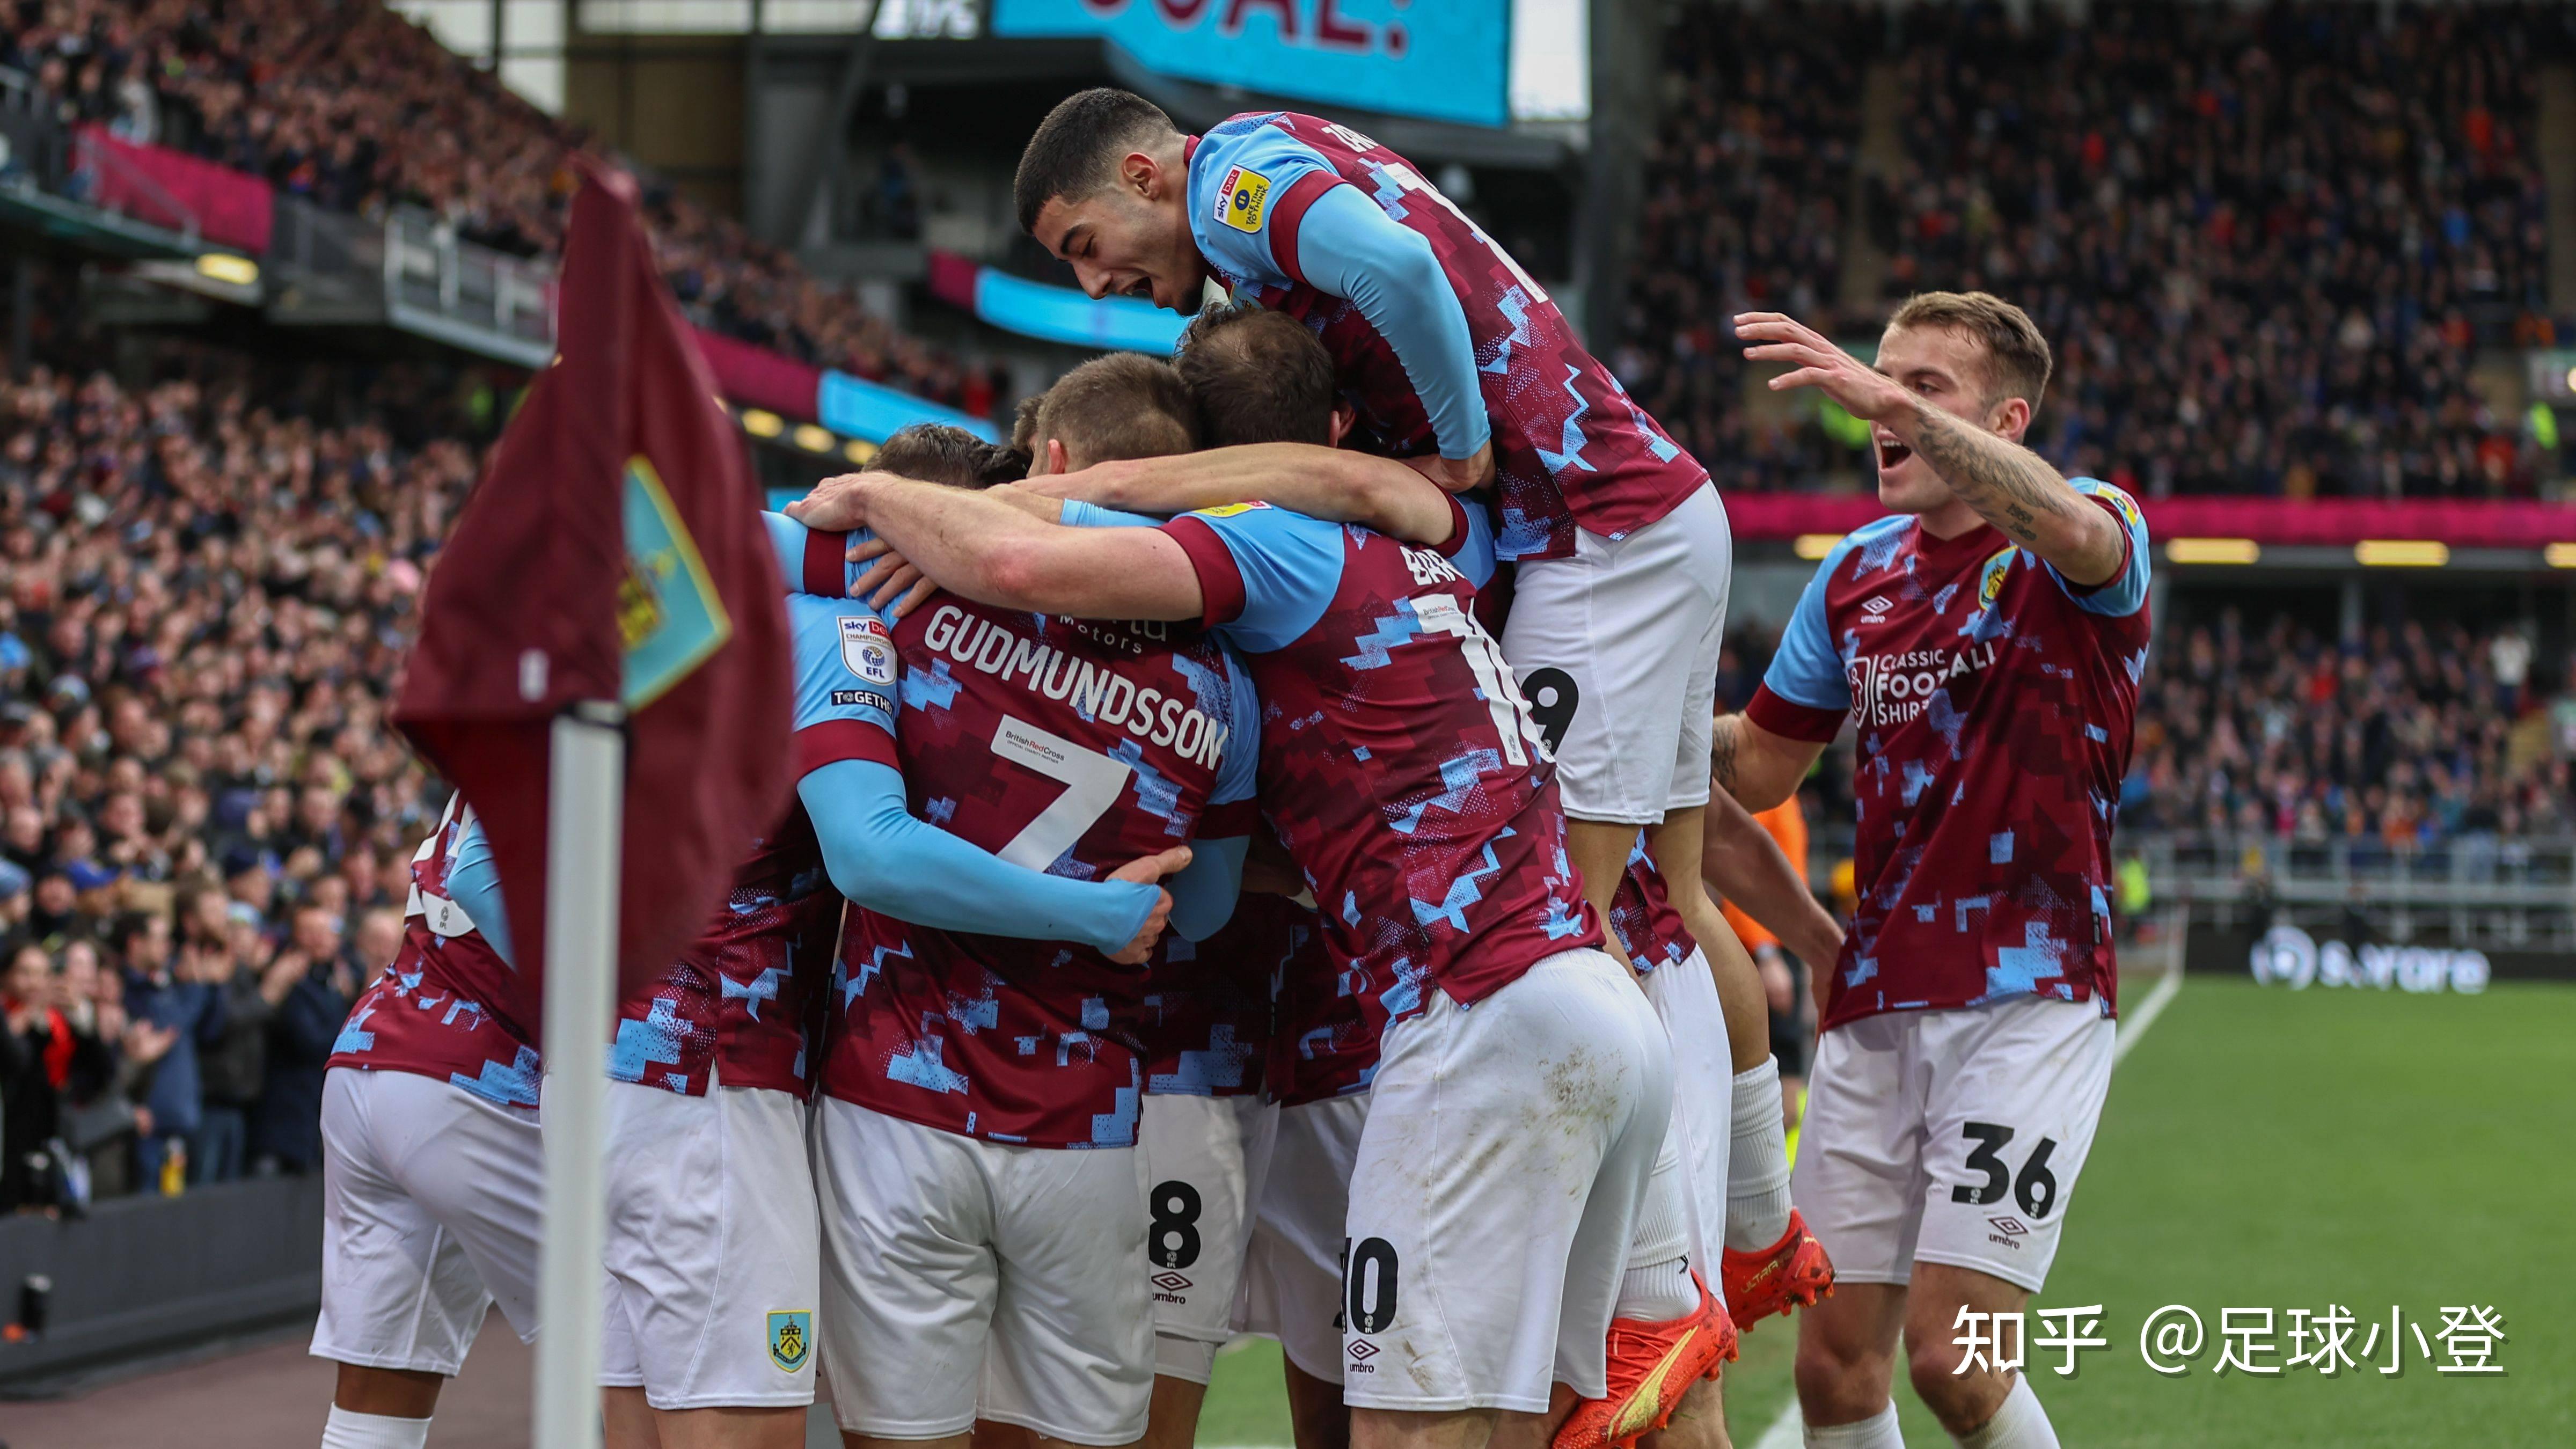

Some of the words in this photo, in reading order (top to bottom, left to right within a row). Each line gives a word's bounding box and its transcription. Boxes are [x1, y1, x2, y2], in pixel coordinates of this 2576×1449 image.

[1217, 195, 1228, 218] sky
[1223, 171, 1238, 193] bet
[1250, 184, 1263, 203] TIME
[1250, 214, 1257, 225] TO
[1254, 187, 1268, 213] THINK
[1246, 204, 1256, 225] TAKE
[844, 621, 867, 632] sky
[866, 667, 885, 678] EFL
[924, 605, 1229, 771] GUDMUNDSSON
[1005, 730, 1065, 761] BritishRedCross
[990, 714, 1131, 873] 7
[1951, 1121, 2058, 1220] 36
[1148, 1180, 1202, 1269] 8
[1989, 1233, 2020, 1250] umbro
[1152, 1292, 1186, 1305] umbro
[1350, 1362, 1375, 1374] umbro
